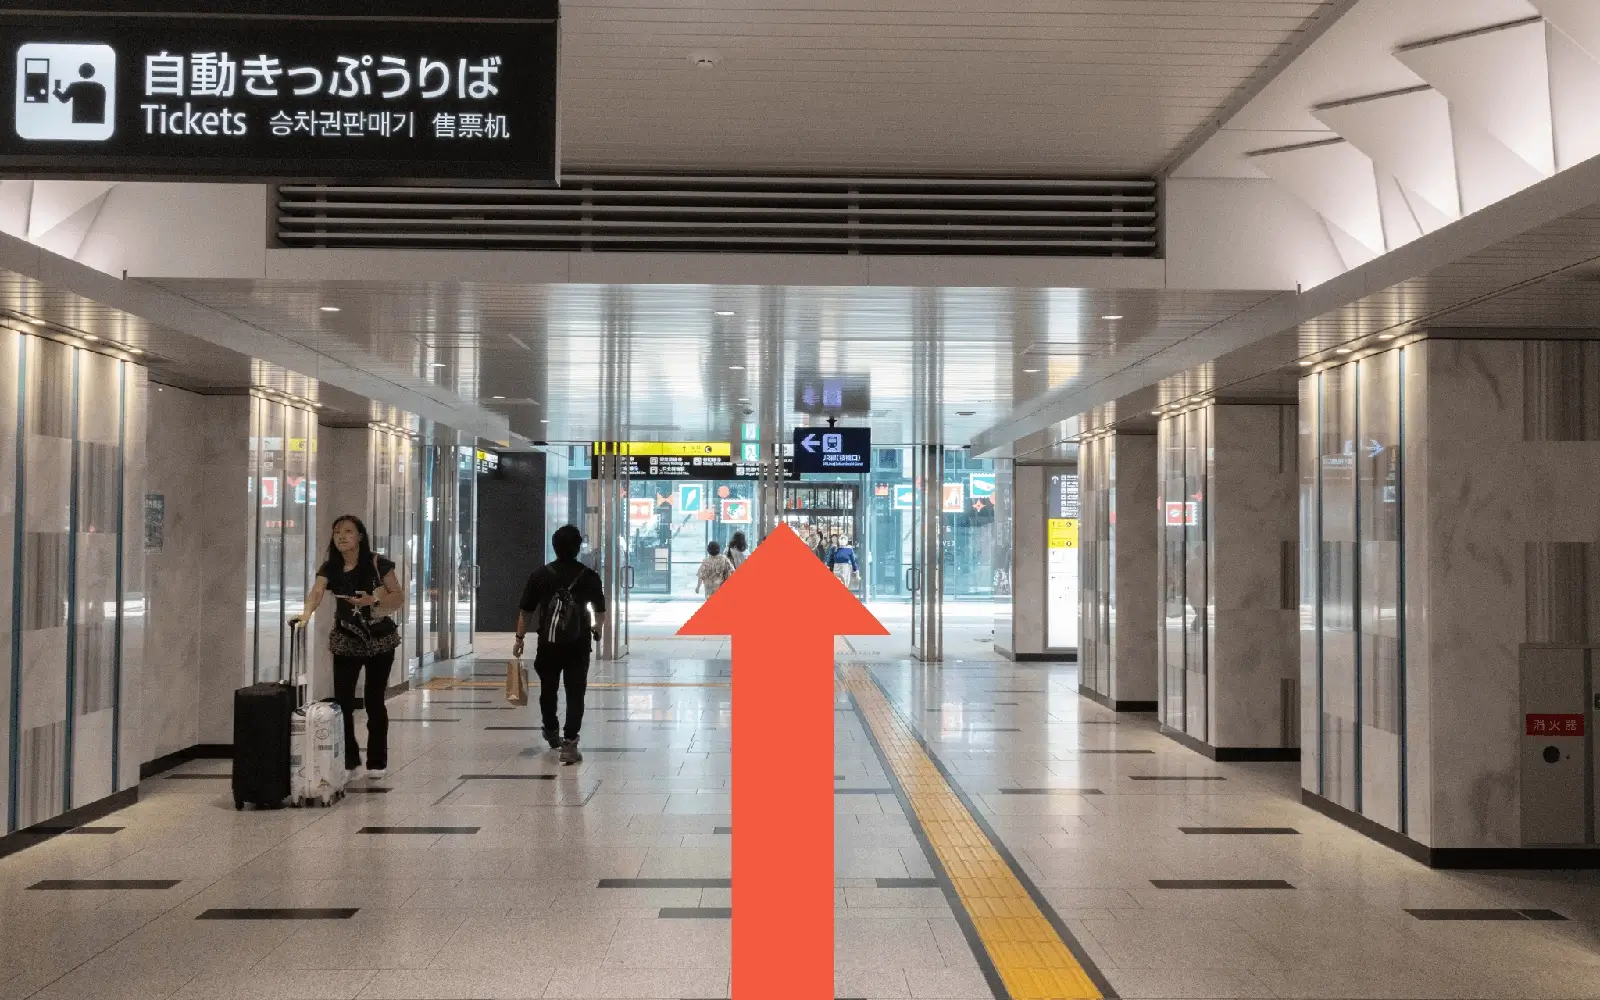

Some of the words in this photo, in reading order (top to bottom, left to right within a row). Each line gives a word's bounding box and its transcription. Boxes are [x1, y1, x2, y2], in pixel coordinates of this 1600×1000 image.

[144, 51, 501, 99] 自動きっぷうりば
[140, 102, 247, 135] Tickets
[269, 110, 415, 137] 승차권판매기
[432, 112, 509, 138] 售票机
[1533, 719, 1578, 731] 消火器
